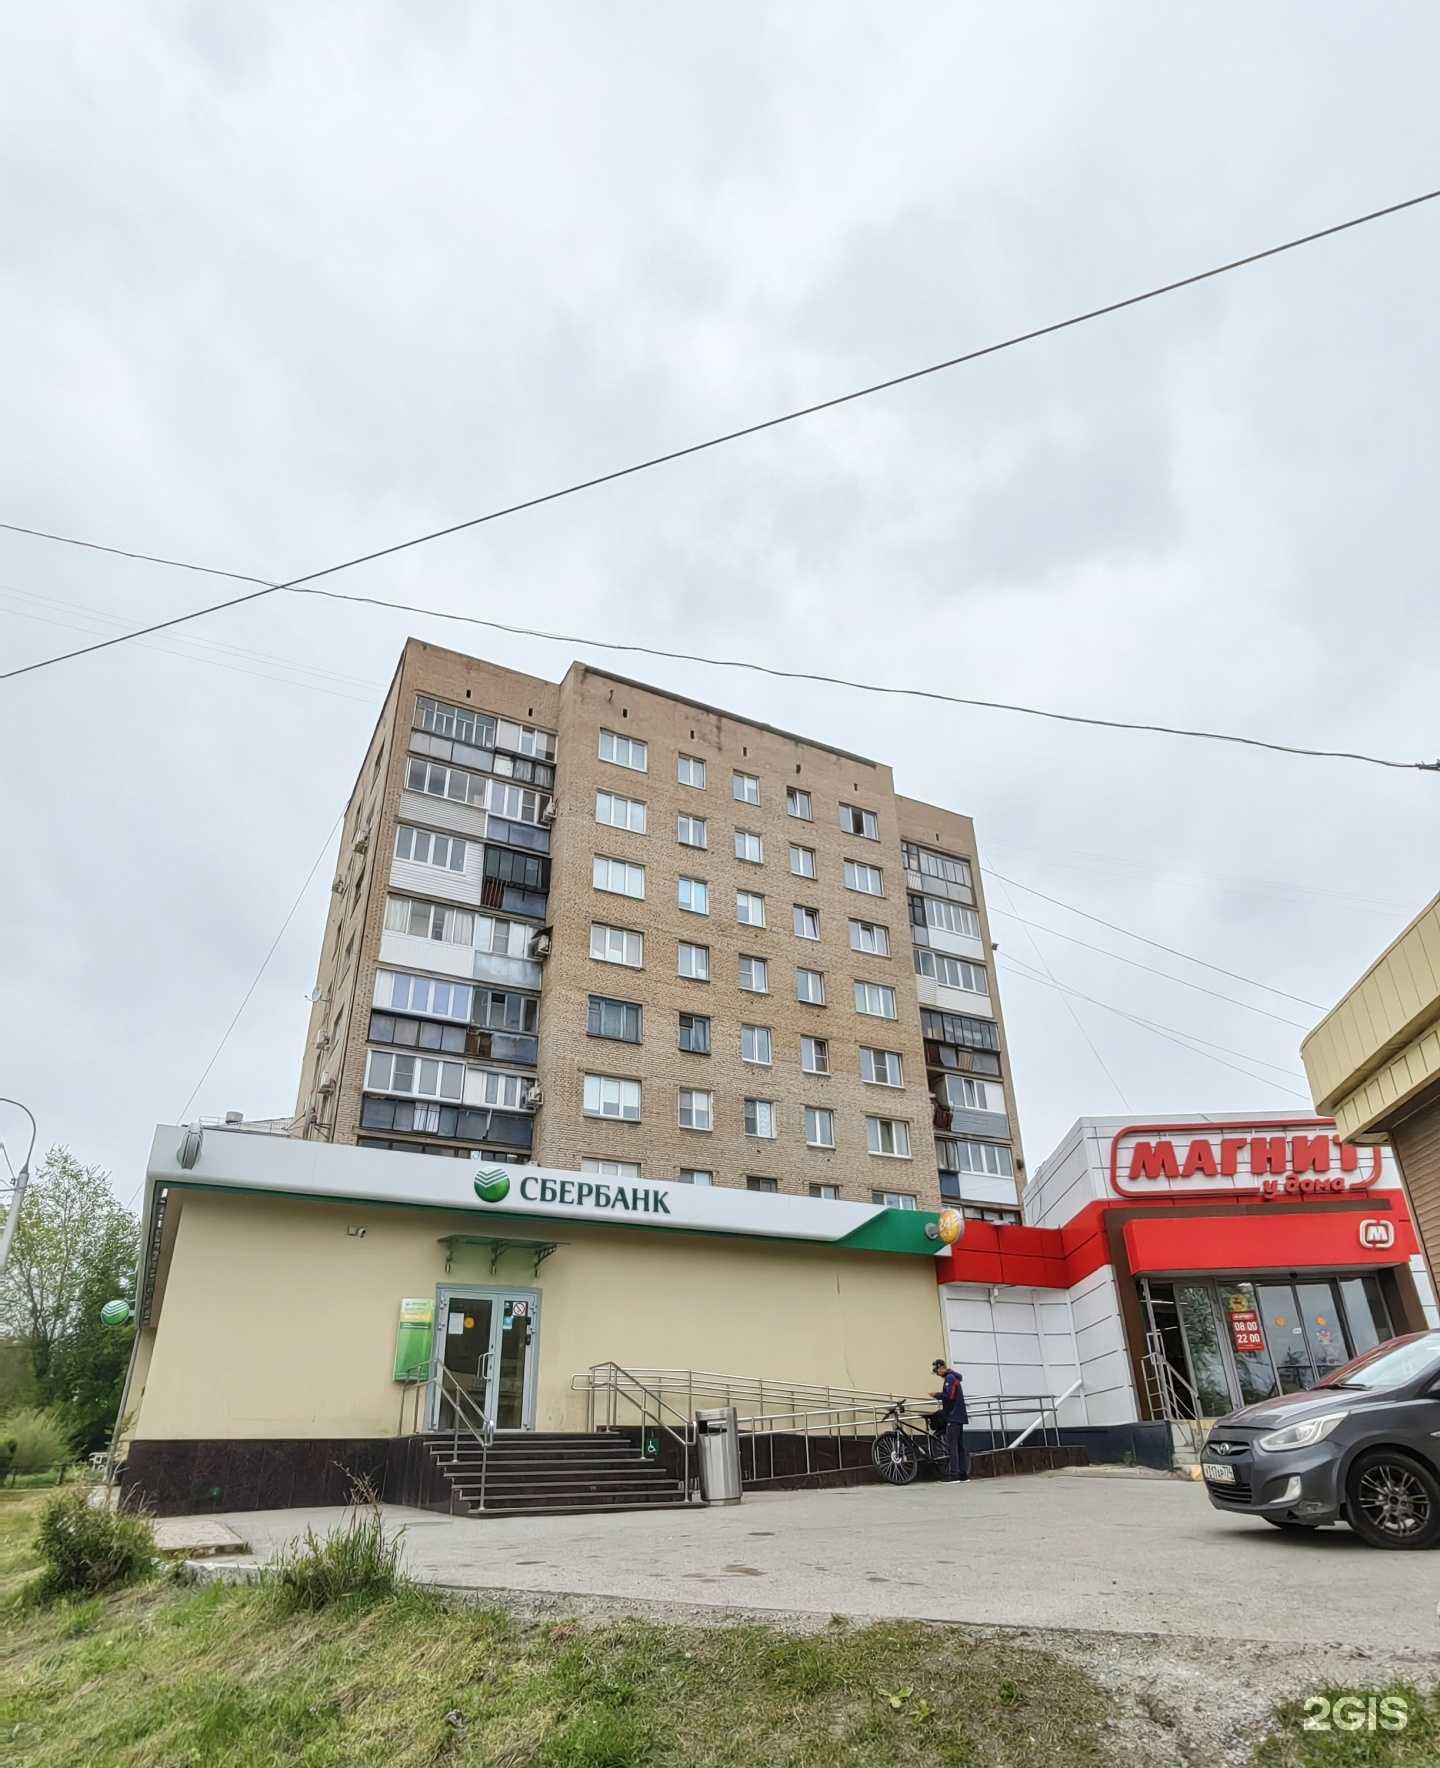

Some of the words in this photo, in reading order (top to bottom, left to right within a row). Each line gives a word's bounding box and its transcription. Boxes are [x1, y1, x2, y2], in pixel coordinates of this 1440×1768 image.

[520, 1176, 671, 1215] СБЕРБАНК
[1263, 1178, 1279, 1199] у
[1285, 1174, 1345, 1194] дома
